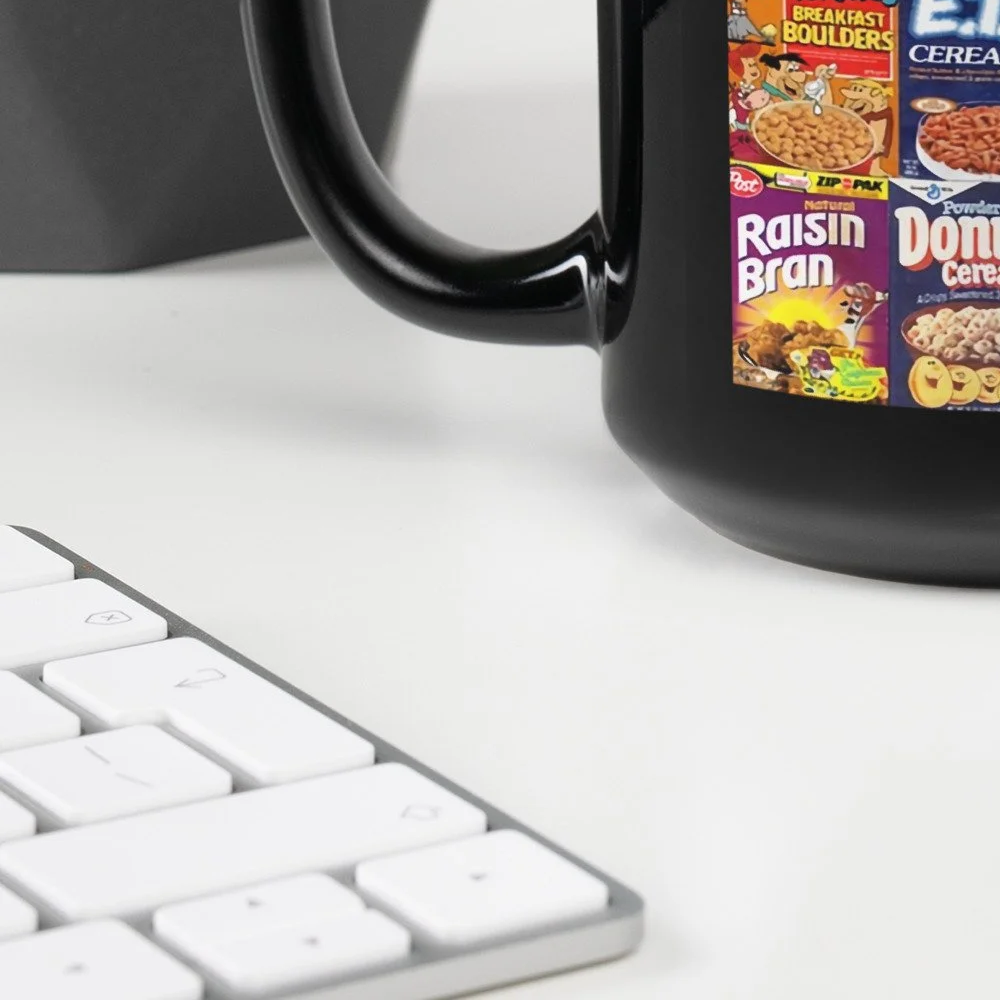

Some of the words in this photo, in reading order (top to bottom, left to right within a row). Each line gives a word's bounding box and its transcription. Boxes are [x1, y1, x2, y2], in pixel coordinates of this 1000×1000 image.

[792, 4, 885, 28] BREAKFAST
[782, 20, 896, 51] BOULDERS
[730, 171, 758, 192] Post
[816, 176, 841, 187] ZIP
[804, 200, 855, 211] Natural
[737, 212, 865, 260] Raisin
[738, 253, 834, 304] Bran
